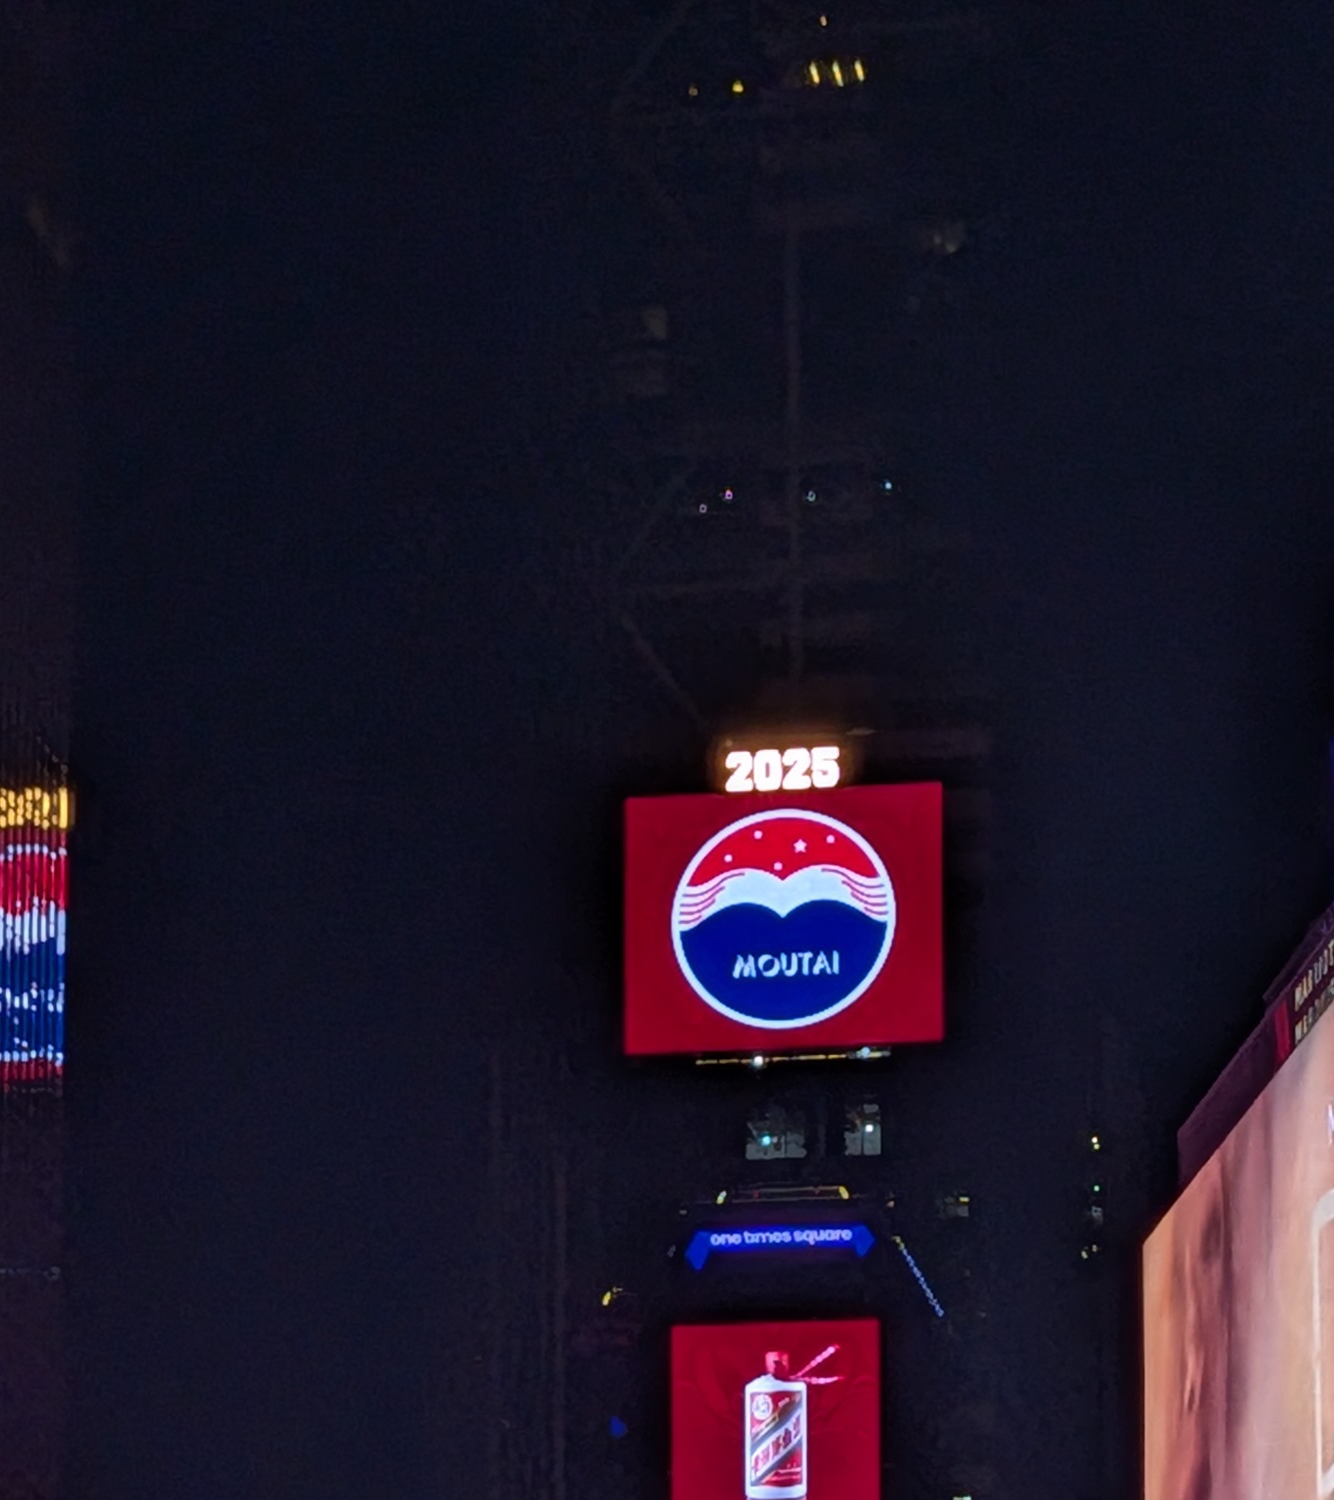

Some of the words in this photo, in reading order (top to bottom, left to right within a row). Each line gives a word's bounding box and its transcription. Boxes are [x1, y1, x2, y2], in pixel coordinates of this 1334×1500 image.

[725, 747, 839, 793] 2025
[733, 951, 839, 978] MOUTAI
[710, 1230, 742, 1246] one
[744, 1229, 791, 1245] times
[794, 1227, 852, 1245] square
